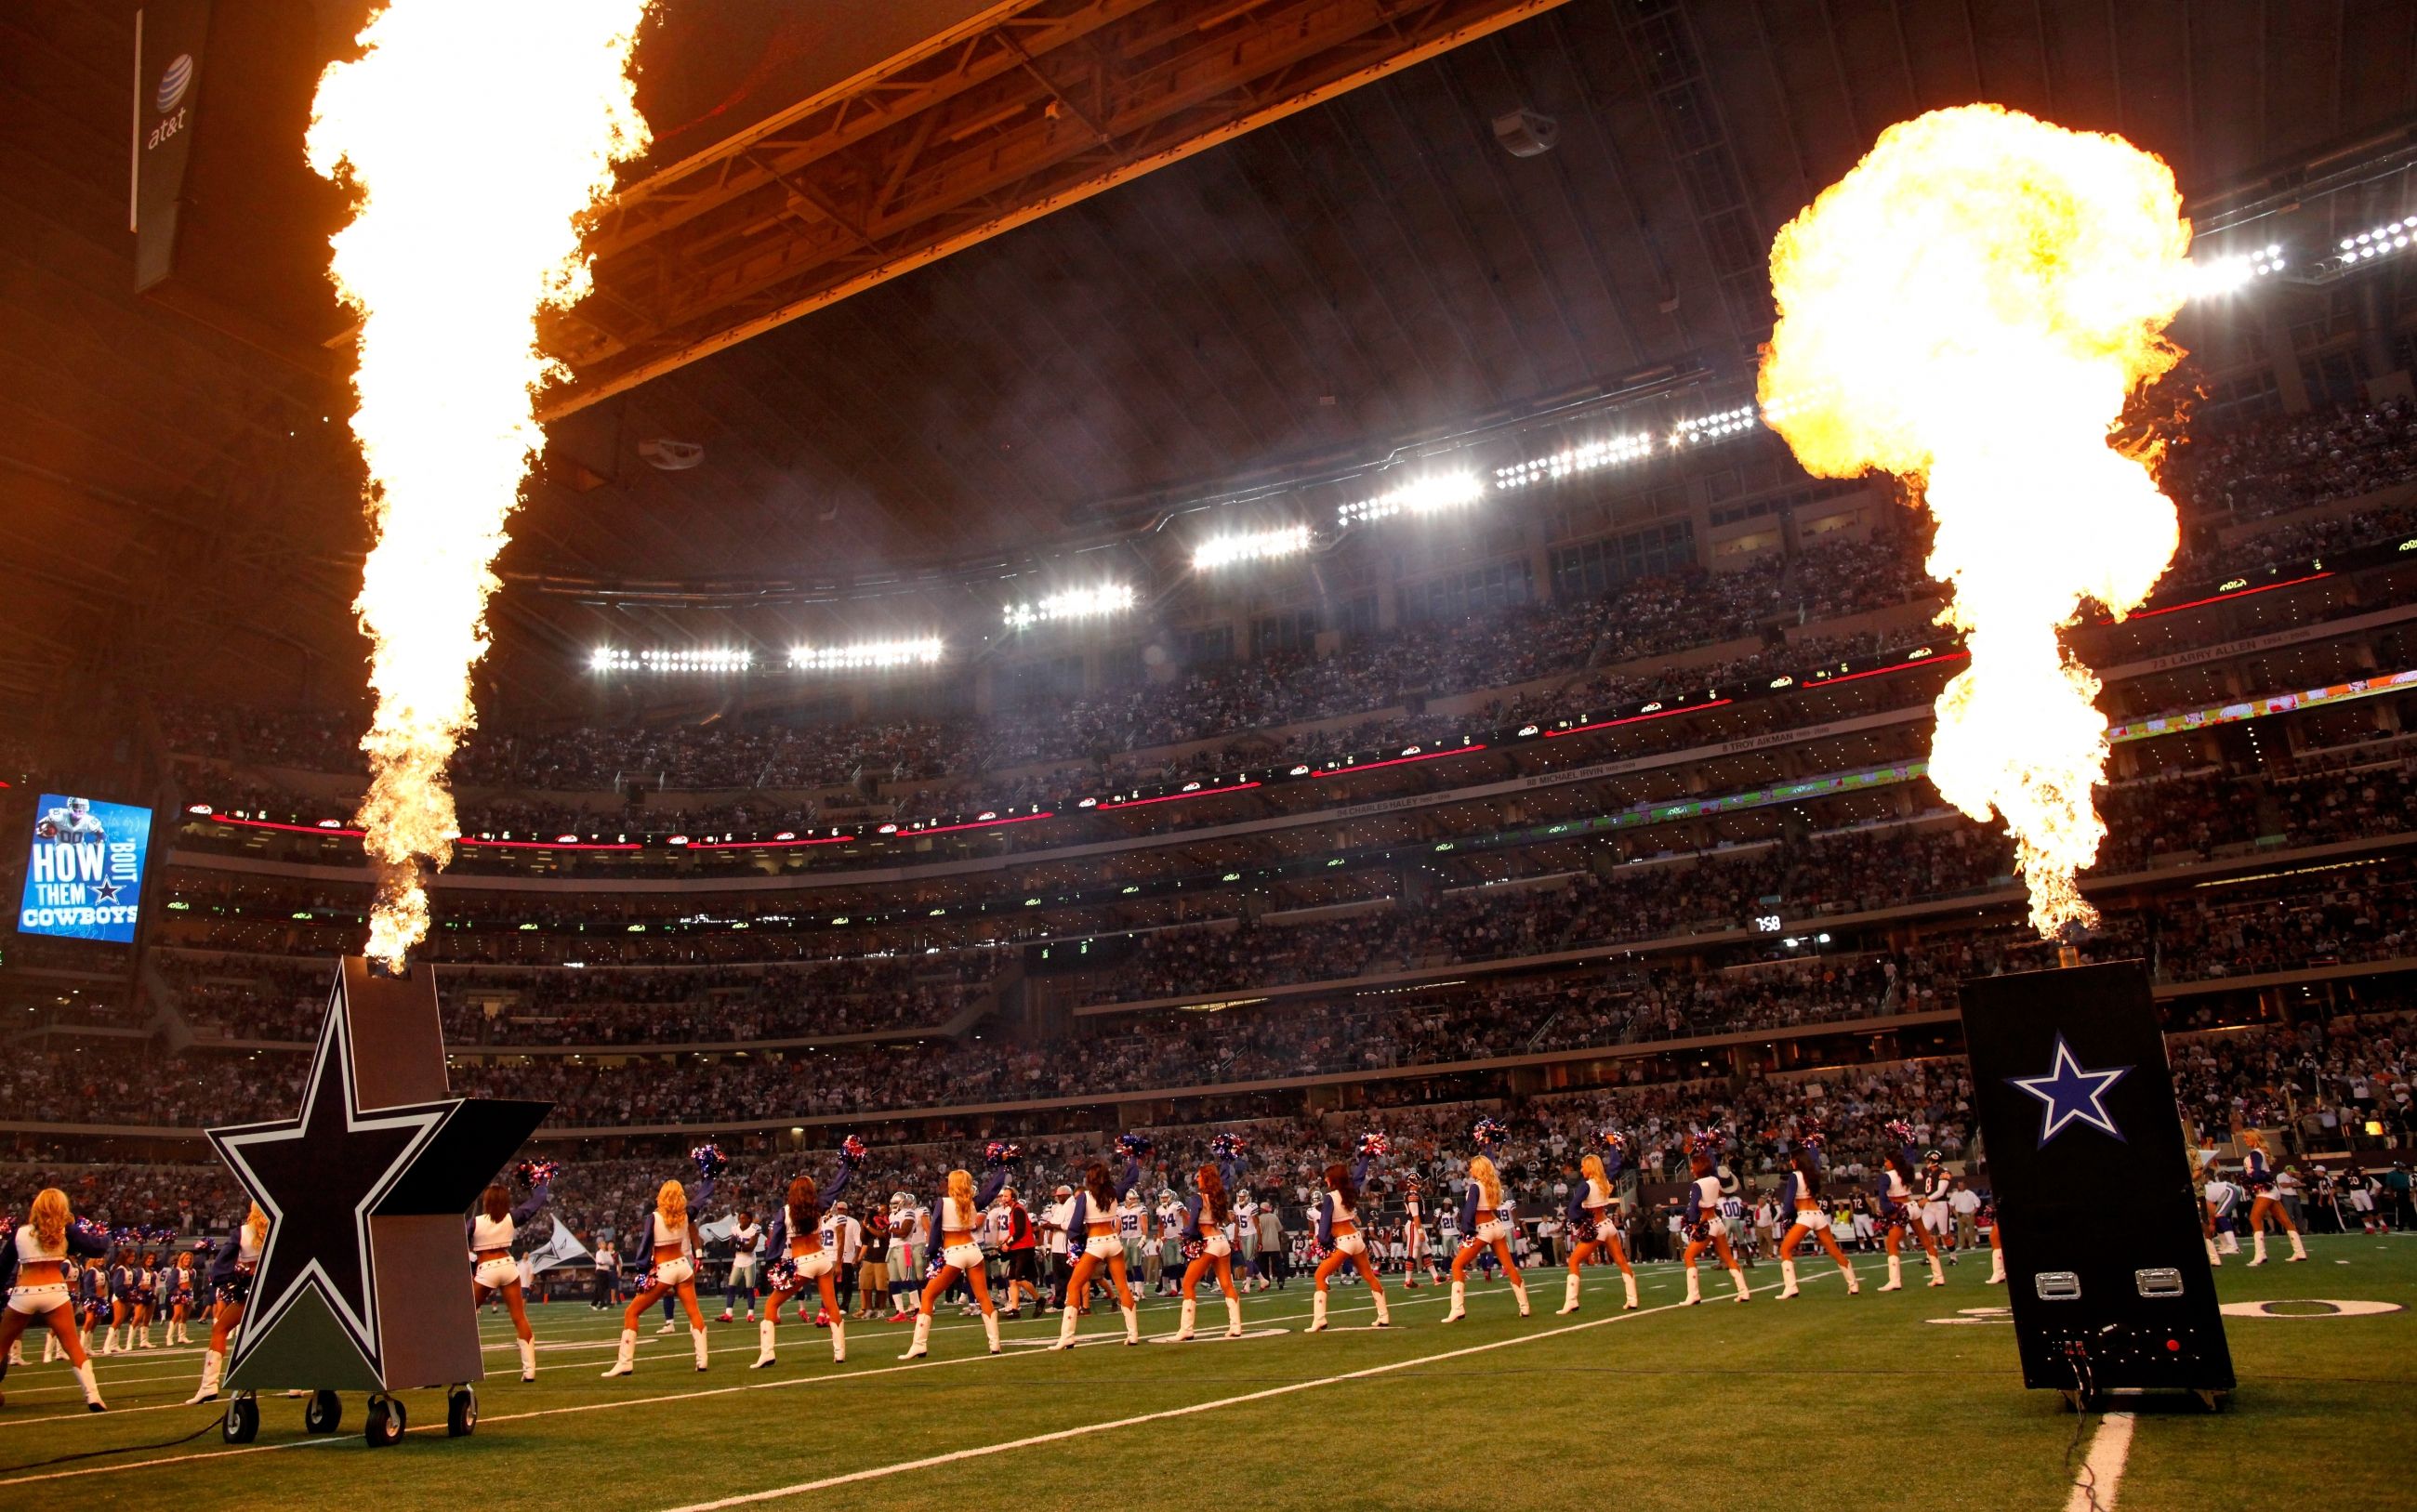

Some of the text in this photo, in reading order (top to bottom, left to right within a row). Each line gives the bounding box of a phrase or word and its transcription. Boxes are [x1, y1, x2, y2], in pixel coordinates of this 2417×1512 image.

[148, 107, 186, 150] at&t
[2152, 658, 2166, 669] 73
[2172, 650, 2211, 664] LARRY
[2215, 640, 2256, 656] ALLEN
[1730, 740, 1755, 751] TROY
[1757, 732, 1793, 745] AIKMAN
[1539, 771, 1578, 783] MICHAEL
[1580, 767, 1604, 777] IRVIN
[1349, 801, 1389, 816] CHARLES
[1390, 797, 1418, 809] HALEY
[33, 843, 106, 882] HOW
[35, 883, 86, 906] THEM
[22, 905, 139, 927] COWBOYS
[1924, 1177, 1933, 1194] 8
[1723, 1201, 1741, 1217] 00
[1816, 1199, 1829, 1211] 79
[1853, 1198, 1863, 1209] 72
[1121, 1215, 1138, 1231] 52
[1442, 1217, 1455, 1229] 21
